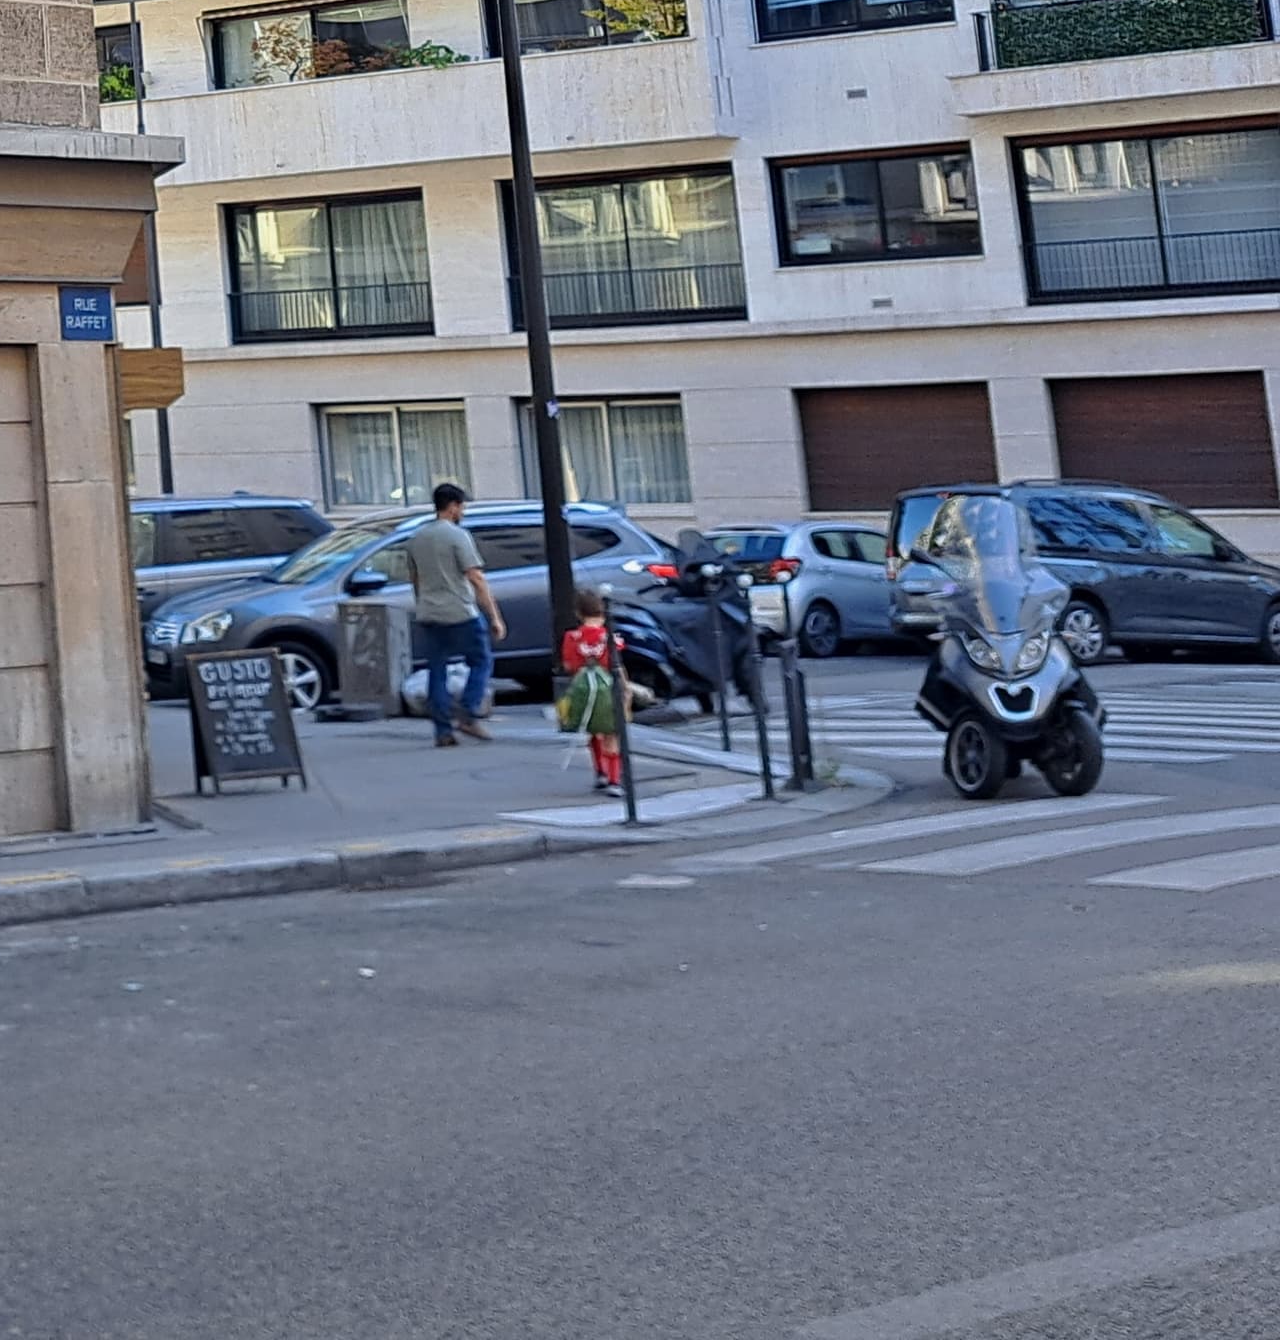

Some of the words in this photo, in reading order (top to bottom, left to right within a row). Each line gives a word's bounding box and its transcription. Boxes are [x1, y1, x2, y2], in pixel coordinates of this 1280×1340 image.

[74, 298, 97, 311] RUE
[65, 315, 107, 329] RAFFET
[198, 658, 271, 683] GUSTO
